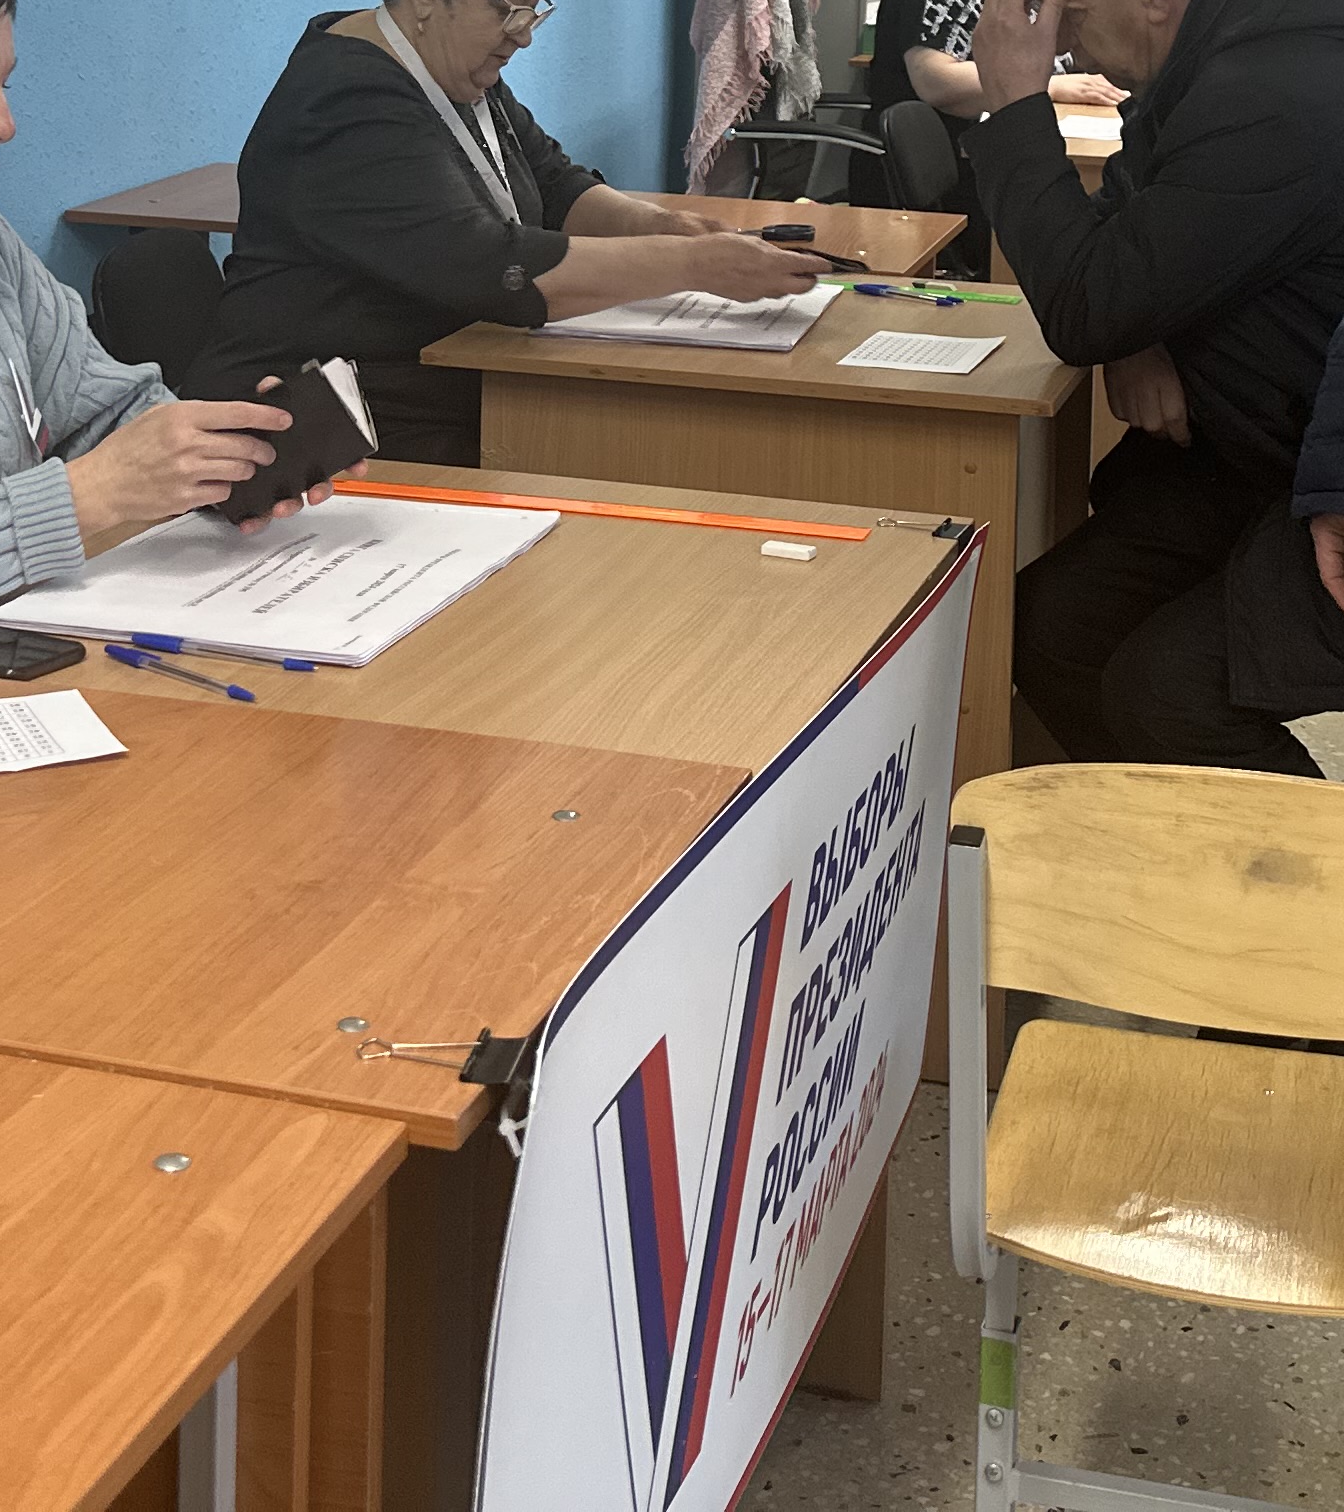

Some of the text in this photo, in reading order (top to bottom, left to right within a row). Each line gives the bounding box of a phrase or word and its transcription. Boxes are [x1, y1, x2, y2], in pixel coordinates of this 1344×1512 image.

[775, 798, 927, 1107] ПРЕЗИДЕНТА
[799, 723, 917, 954] ВЫБОРЫ
[750, 998, 867, 1265] РОССИИ
[797, 1110, 855, 1270] МАРТА
